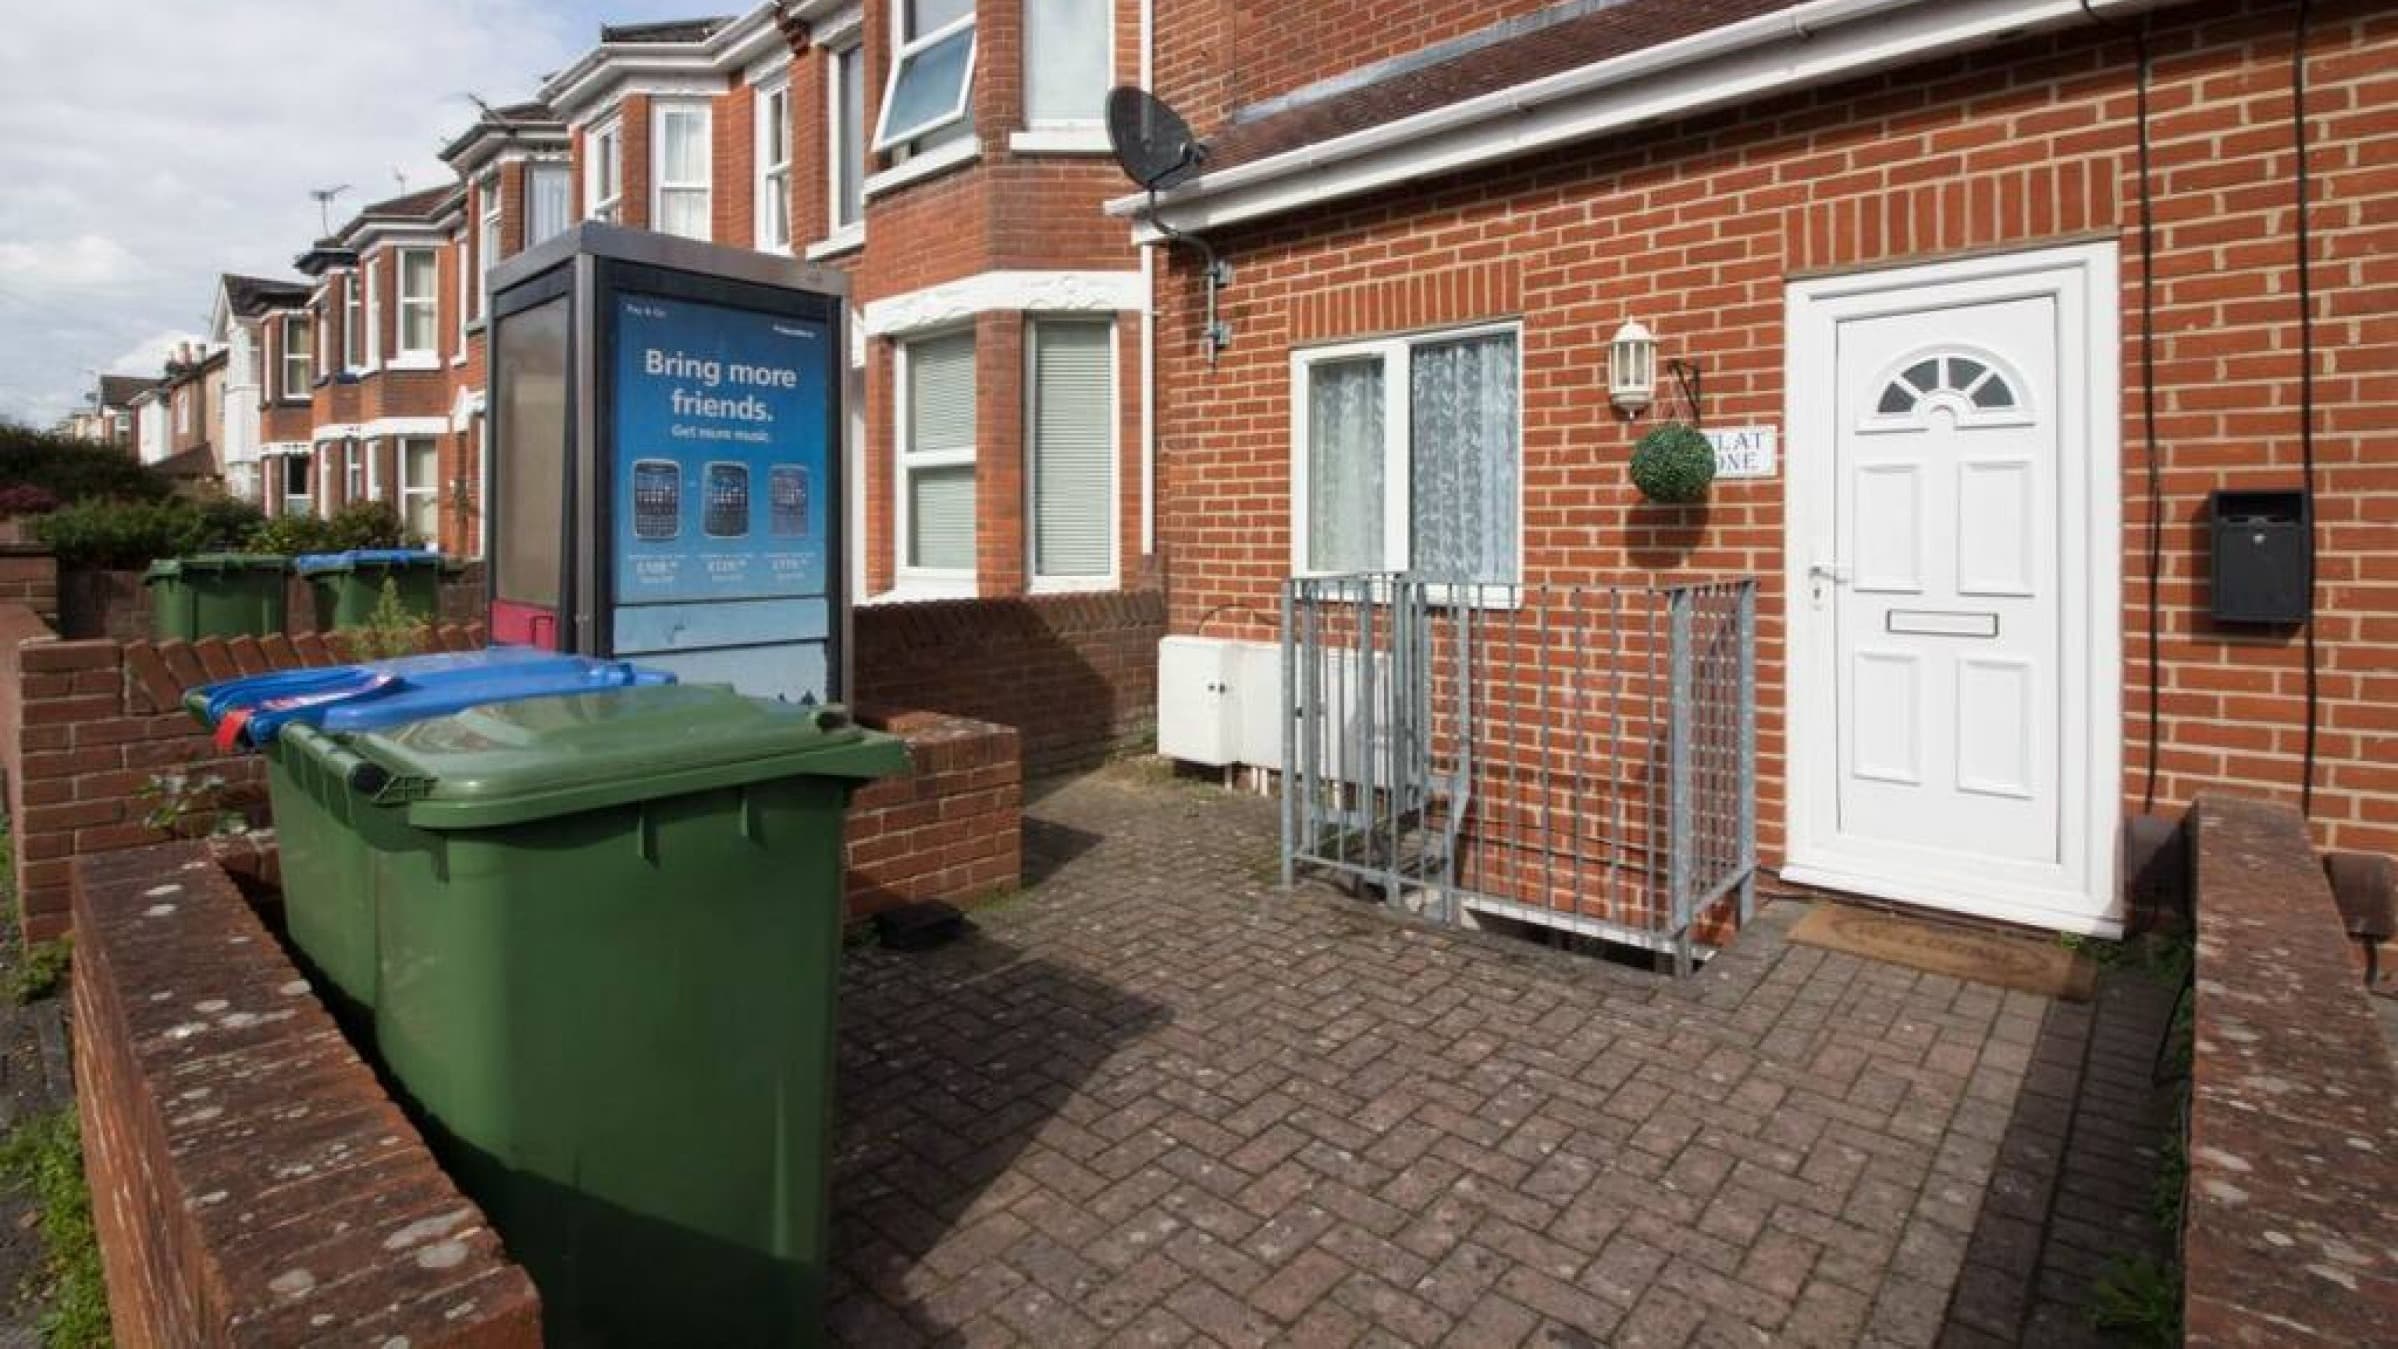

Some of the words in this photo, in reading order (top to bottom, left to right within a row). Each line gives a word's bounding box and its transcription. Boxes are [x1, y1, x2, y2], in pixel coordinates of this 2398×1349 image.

[645, 348, 720, 387] Bring
[729, 363, 798, 388] more
[671, 387, 775, 422] friends.
[671, 424, 697, 440] Get
[1712, 432, 1763, 451] LAT
